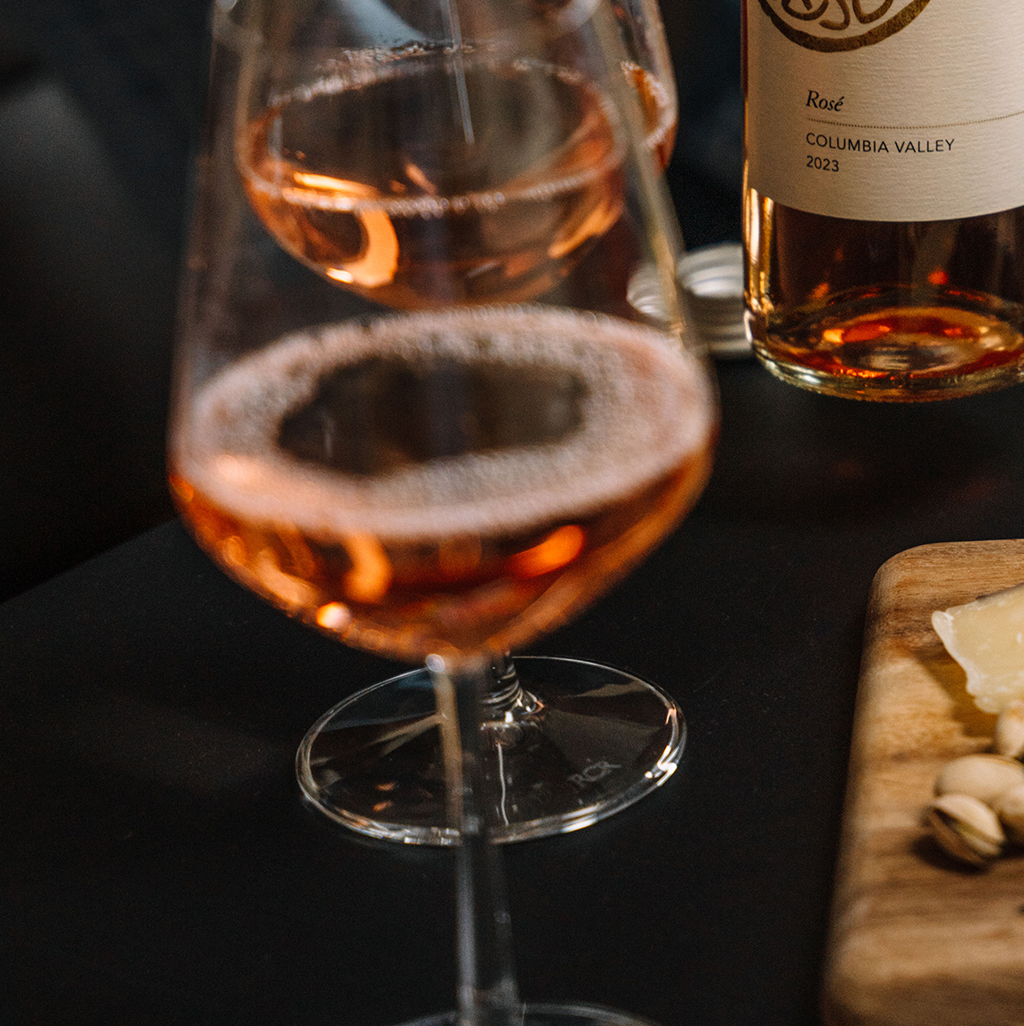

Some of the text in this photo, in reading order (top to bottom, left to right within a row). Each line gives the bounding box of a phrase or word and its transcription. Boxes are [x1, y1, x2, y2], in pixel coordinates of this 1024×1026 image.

[805, 90, 845, 112] Rosé
[806, 132, 955, 153] COLUMBIA VALLEY
[806, 155, 840, 173] 2023
